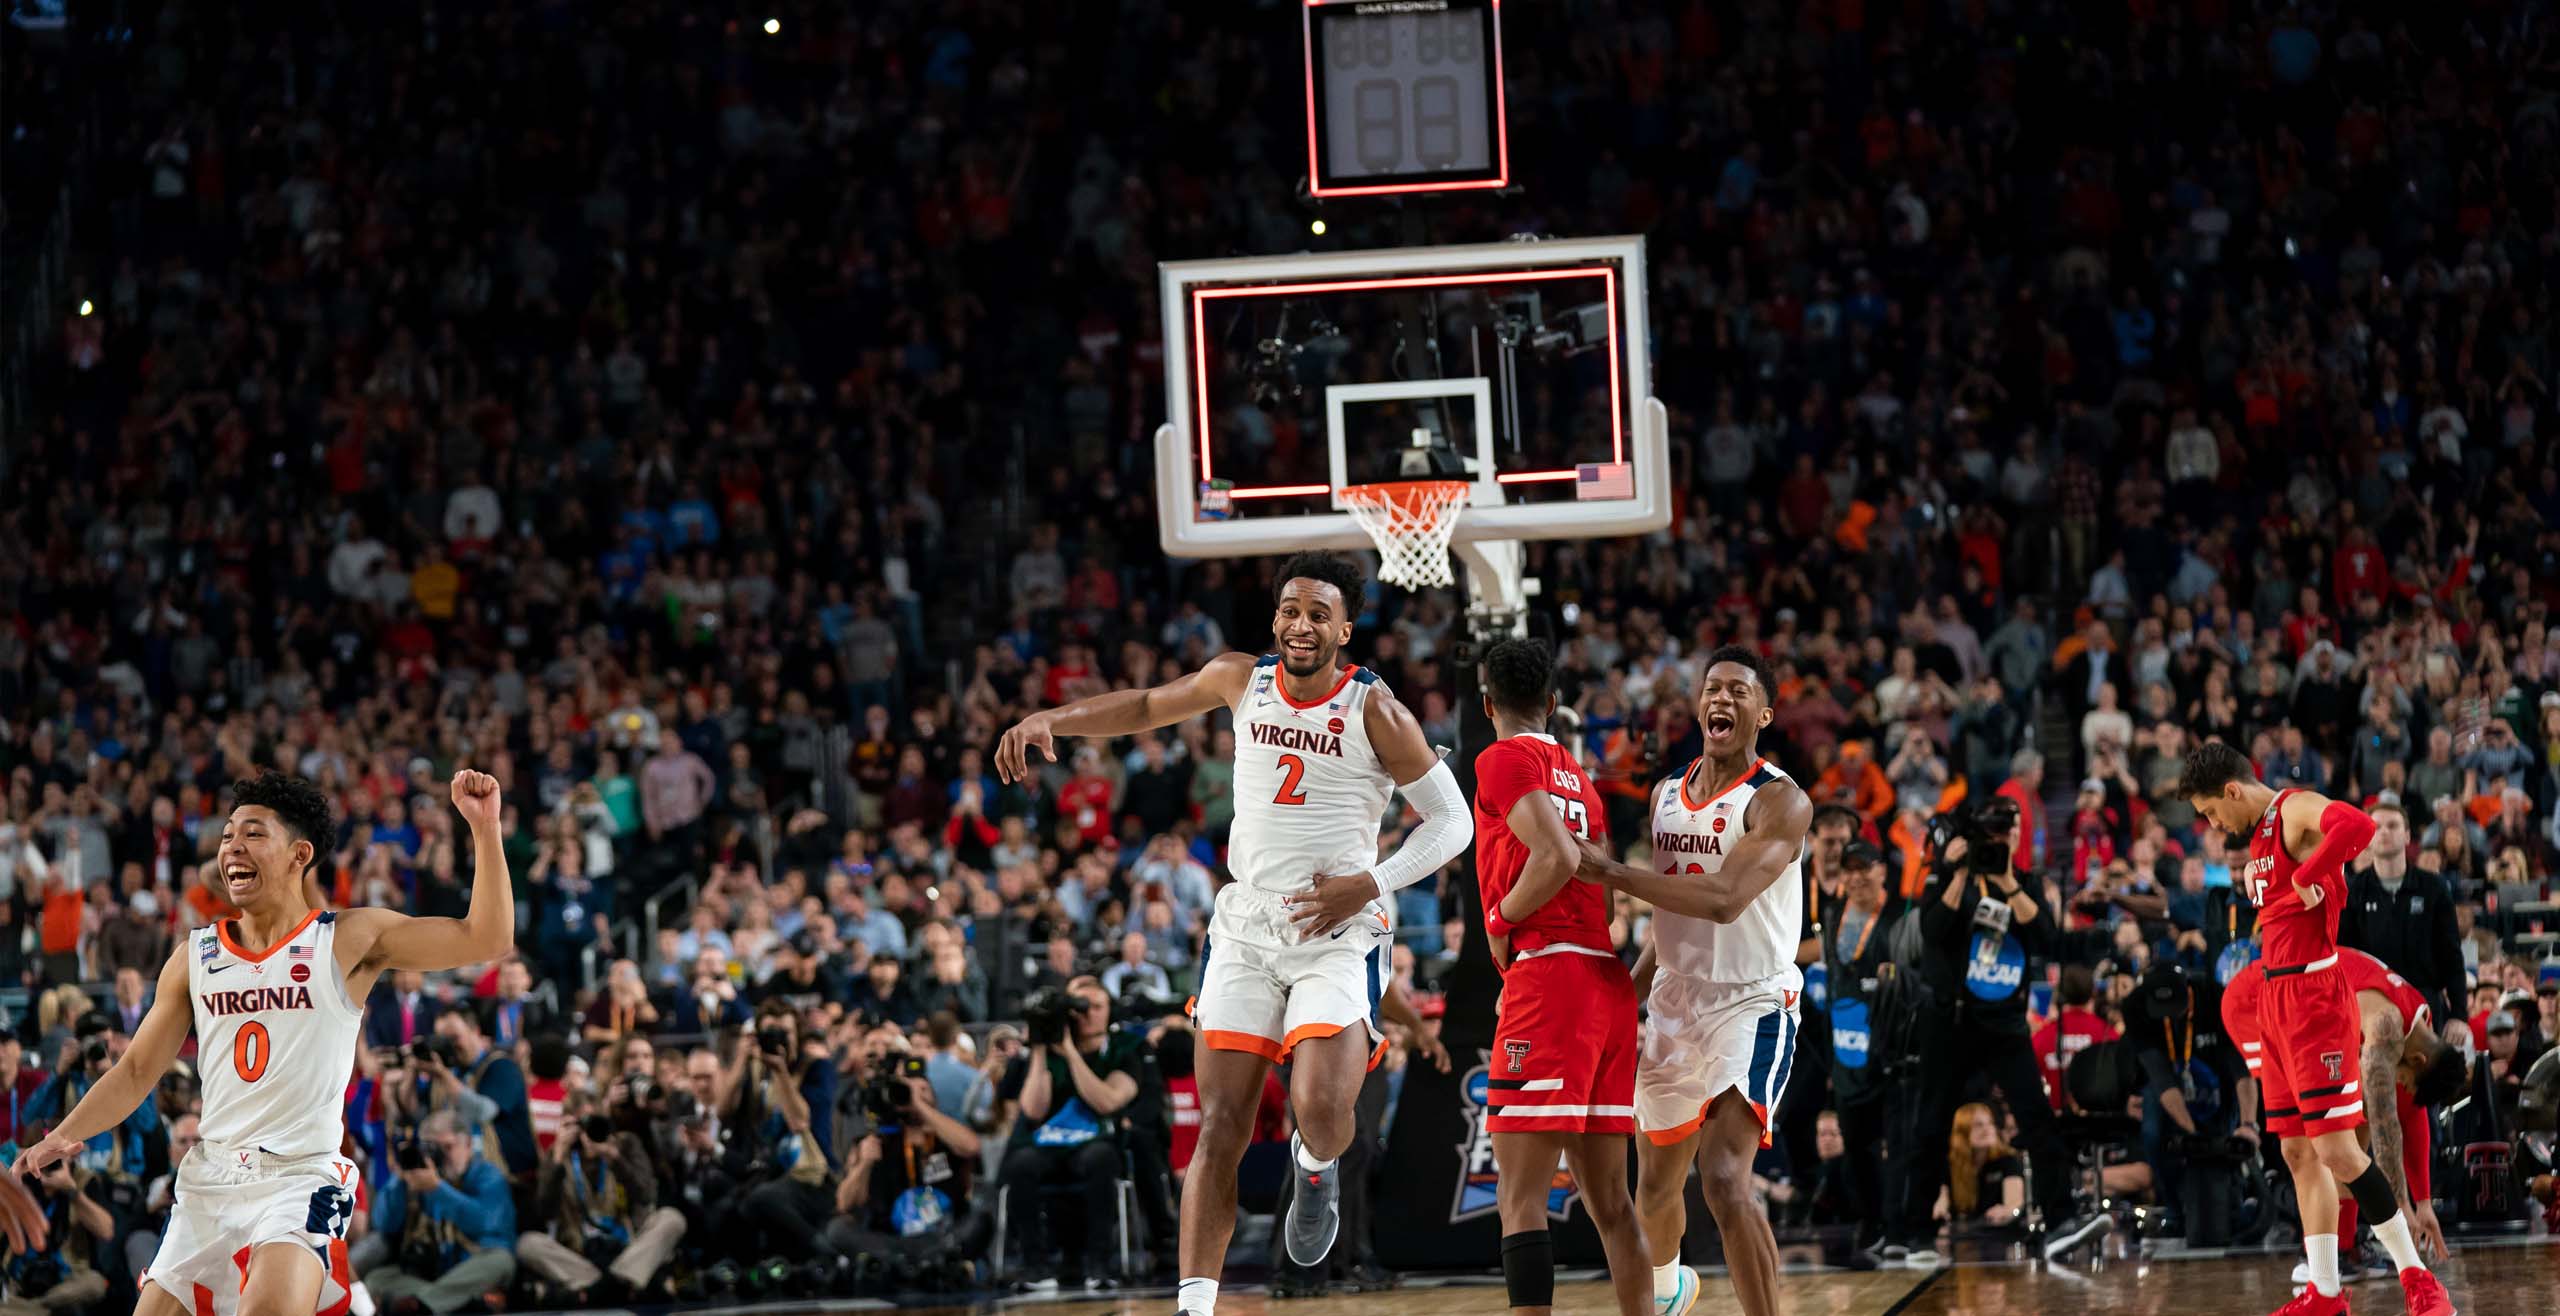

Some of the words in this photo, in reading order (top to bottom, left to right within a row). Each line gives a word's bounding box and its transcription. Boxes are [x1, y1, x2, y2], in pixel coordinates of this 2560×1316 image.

[1250, 722, 1343, 758] VIRGINIA
[1272, 753, 1308, 805] 2
[1656, 832, 1723, 856] VIRGINIA
[1966, 960, 2022, 987] NCAA
[201, 986, 315, 1018] VIRGINIA
[234, 1020, 271, 1083] 0
